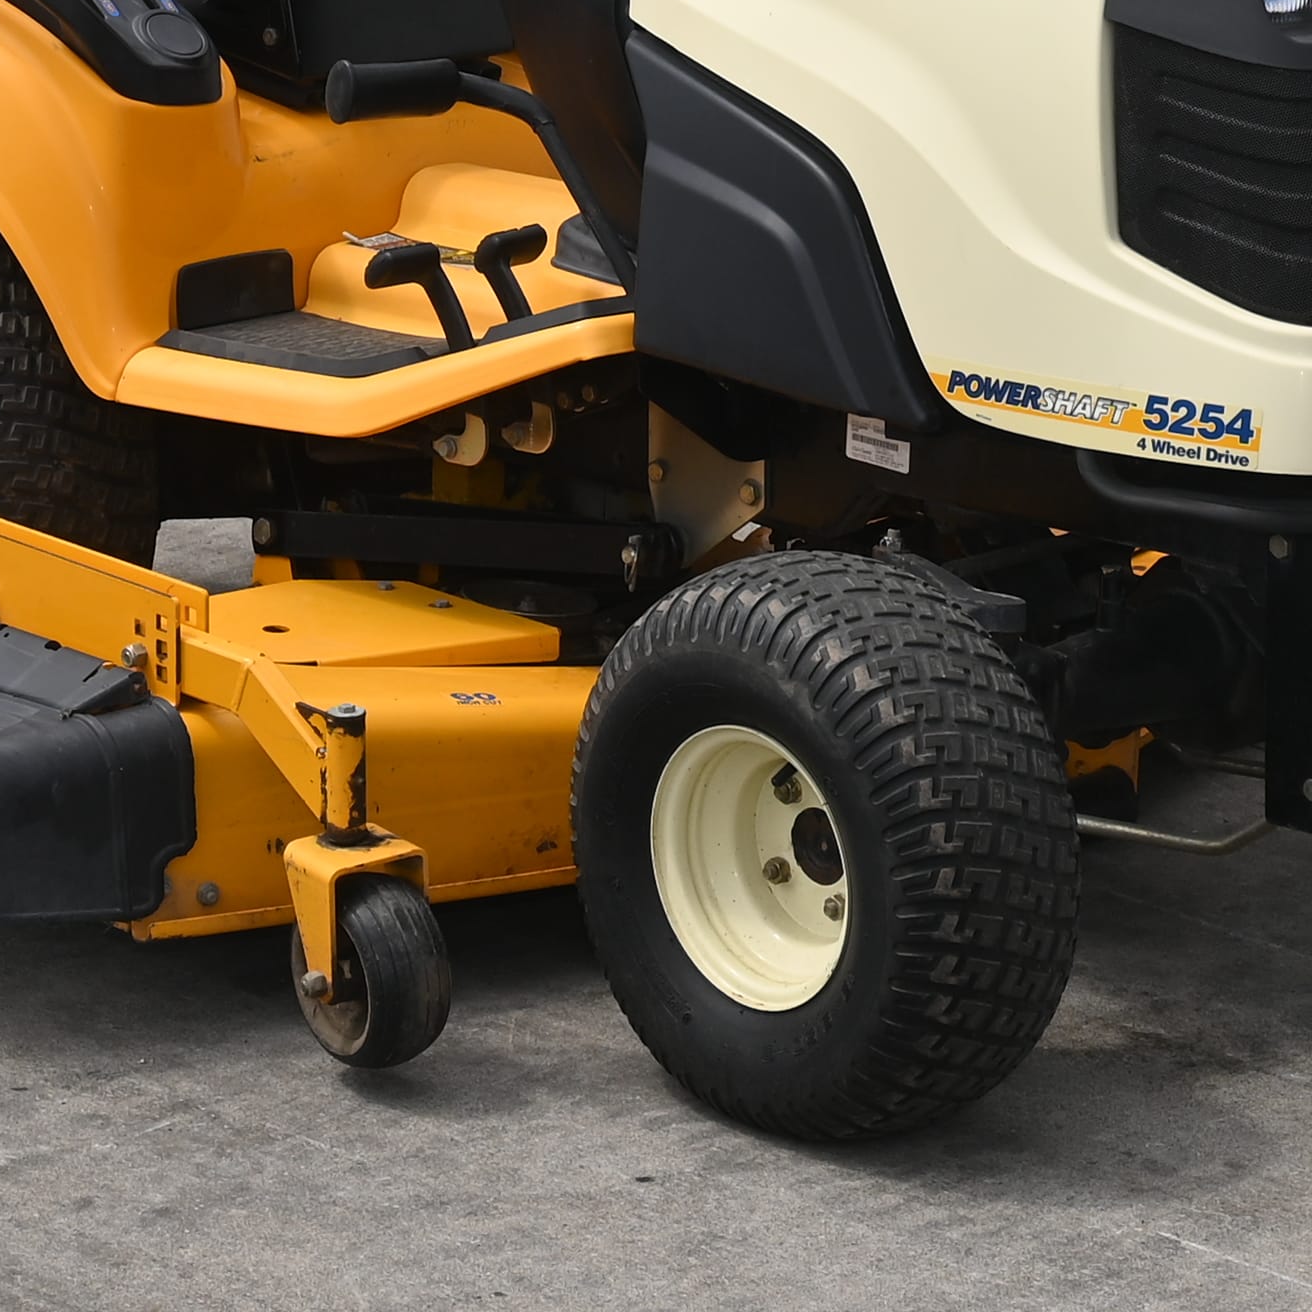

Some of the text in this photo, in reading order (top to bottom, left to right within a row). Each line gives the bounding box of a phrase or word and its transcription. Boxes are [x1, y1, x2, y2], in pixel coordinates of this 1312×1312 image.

[946, 369, 1255, 445] POWERSHAFT 5254
[1135, 437, 1250, 468] 4 Wheel Drive
